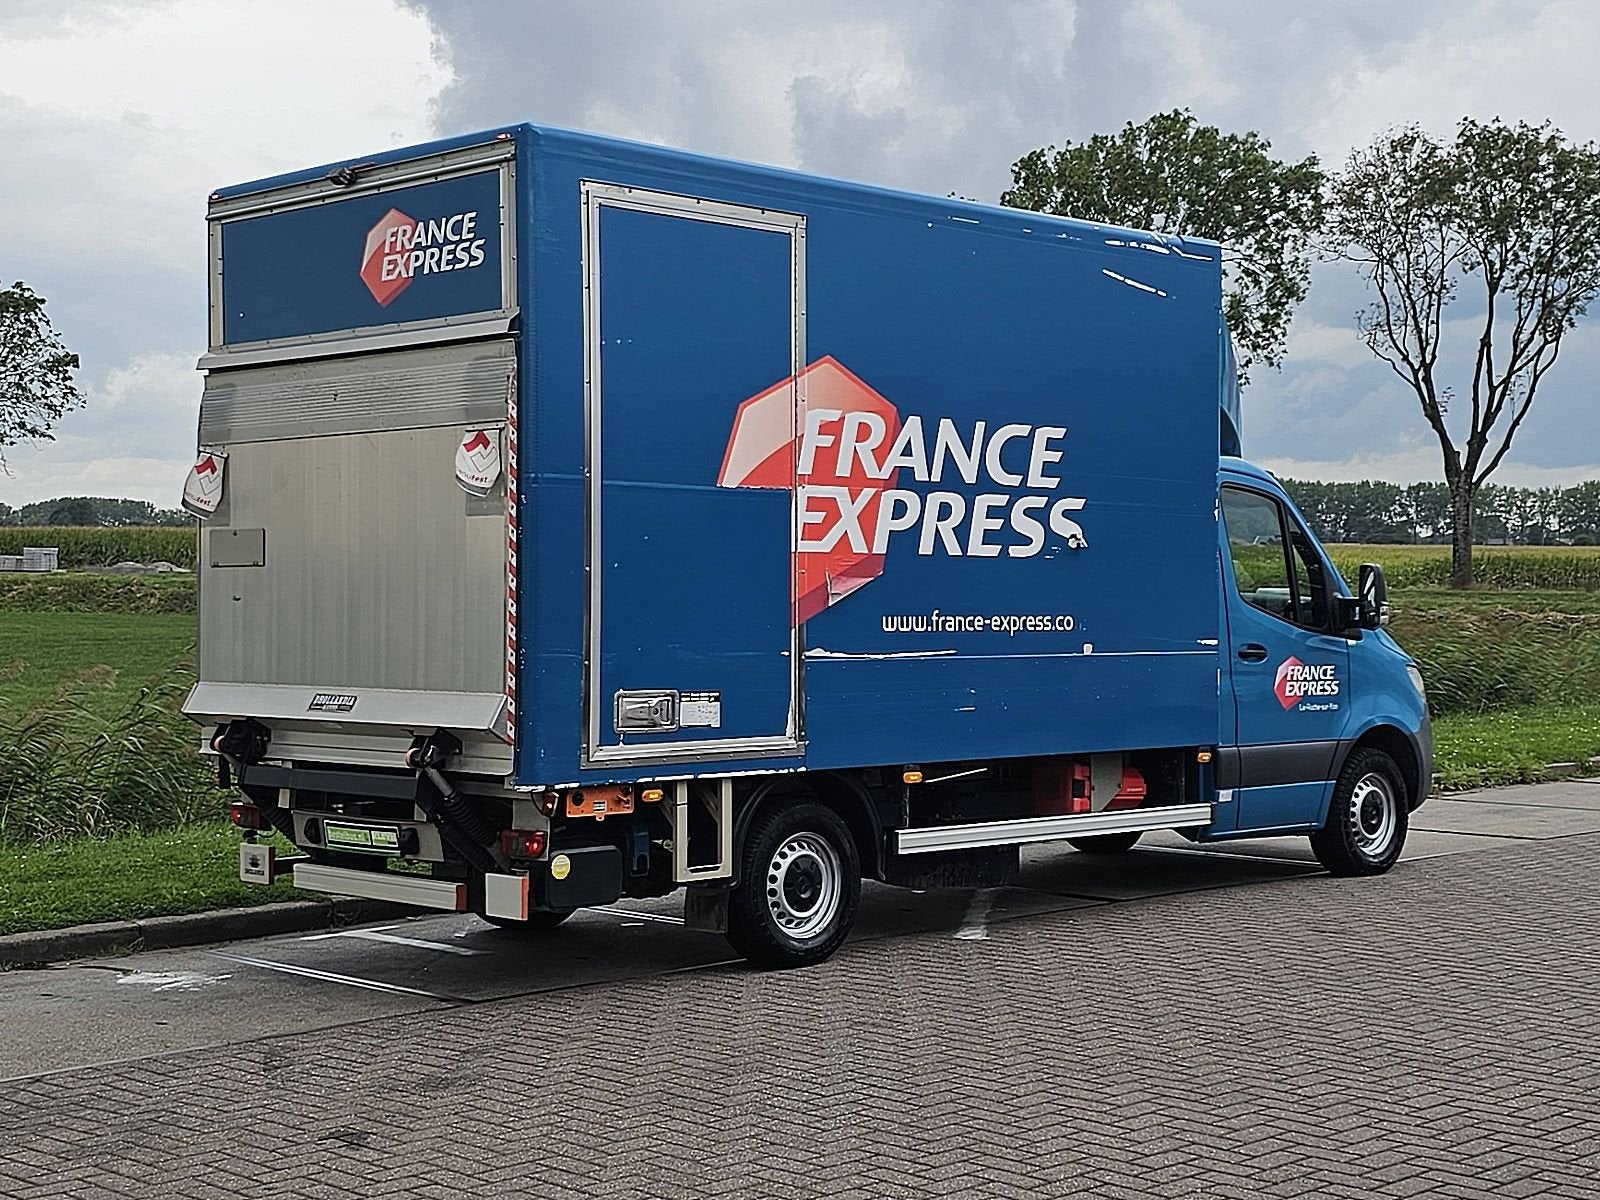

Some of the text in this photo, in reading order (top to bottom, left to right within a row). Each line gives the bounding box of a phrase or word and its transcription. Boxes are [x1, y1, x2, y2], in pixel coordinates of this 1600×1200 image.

[384, 211, 477, 253] FRANCE
[381, 238, 486, 282] EXPRESS
[797, 408, 1067, 488] FRANCE
[793, 485, 1088, 558] EXPRESS
[881, 609, 1074, 636] www.france-express.co
[1284, 680, 1340, 697] EXPRESS
[1286, 665, 1336, 680] FRANCE
